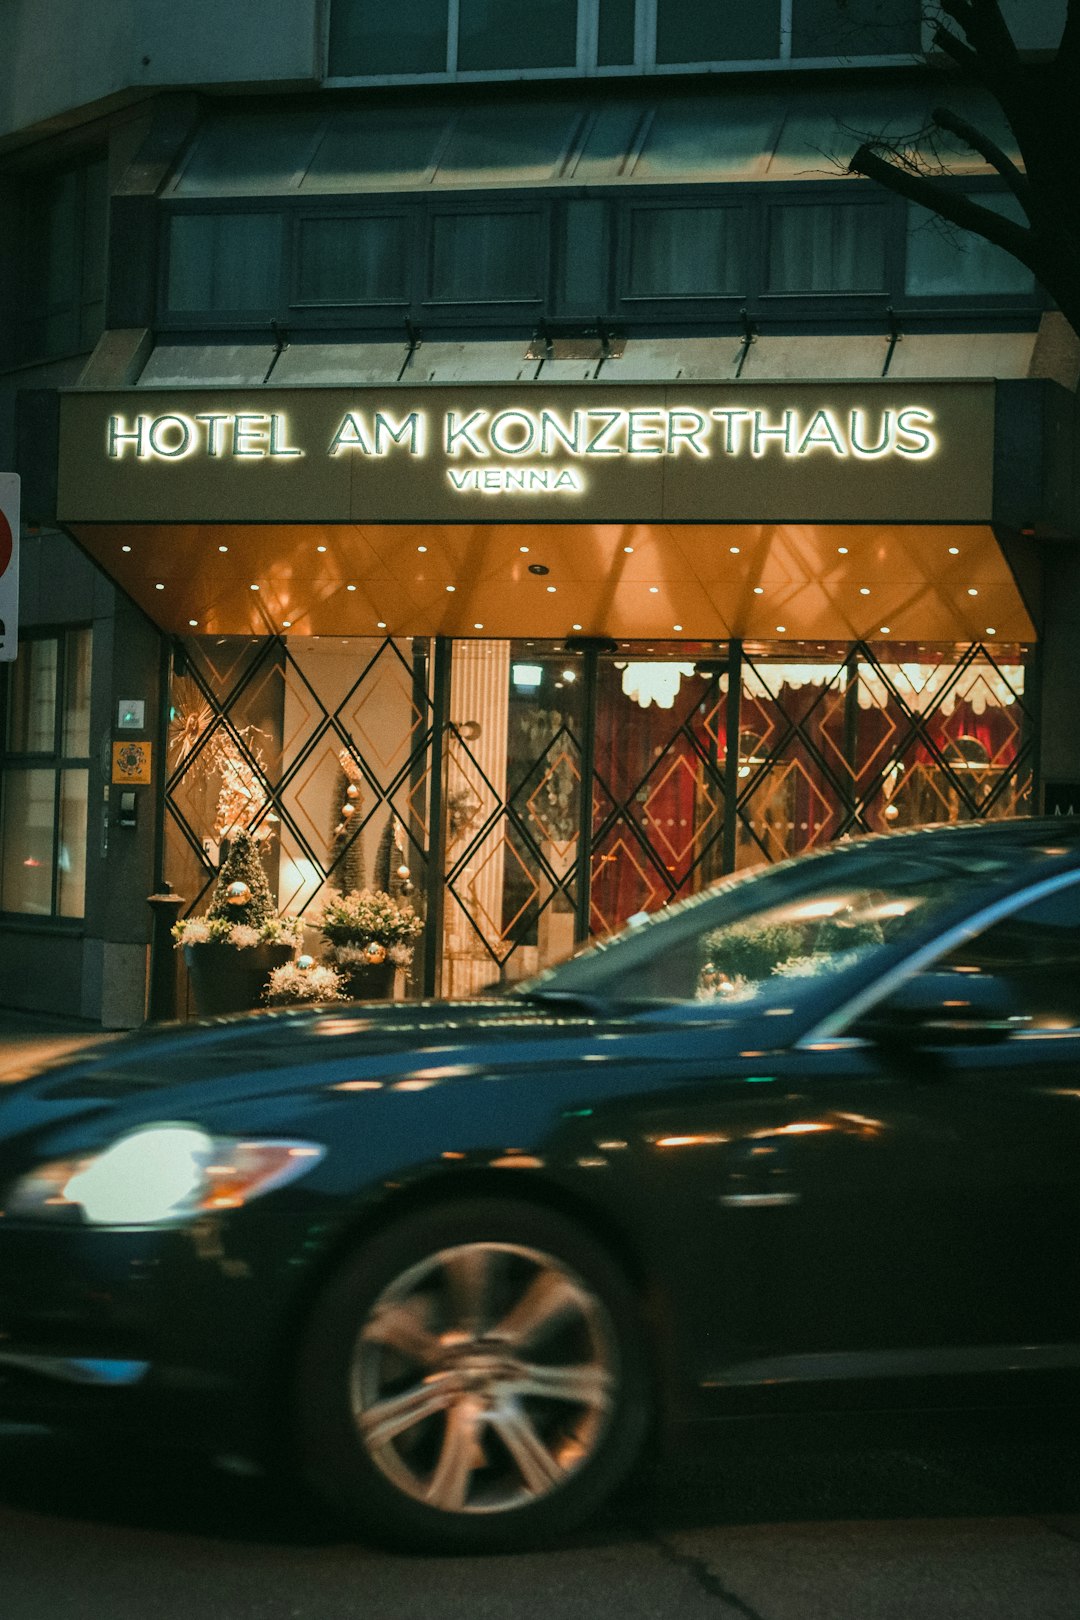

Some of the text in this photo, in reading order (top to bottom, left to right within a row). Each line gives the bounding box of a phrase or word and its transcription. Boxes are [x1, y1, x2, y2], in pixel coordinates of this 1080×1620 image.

[107, 408, 934, 458] HOTEL AM KONZERTHAUS
[447, 469, 580, 492] VIENNA
